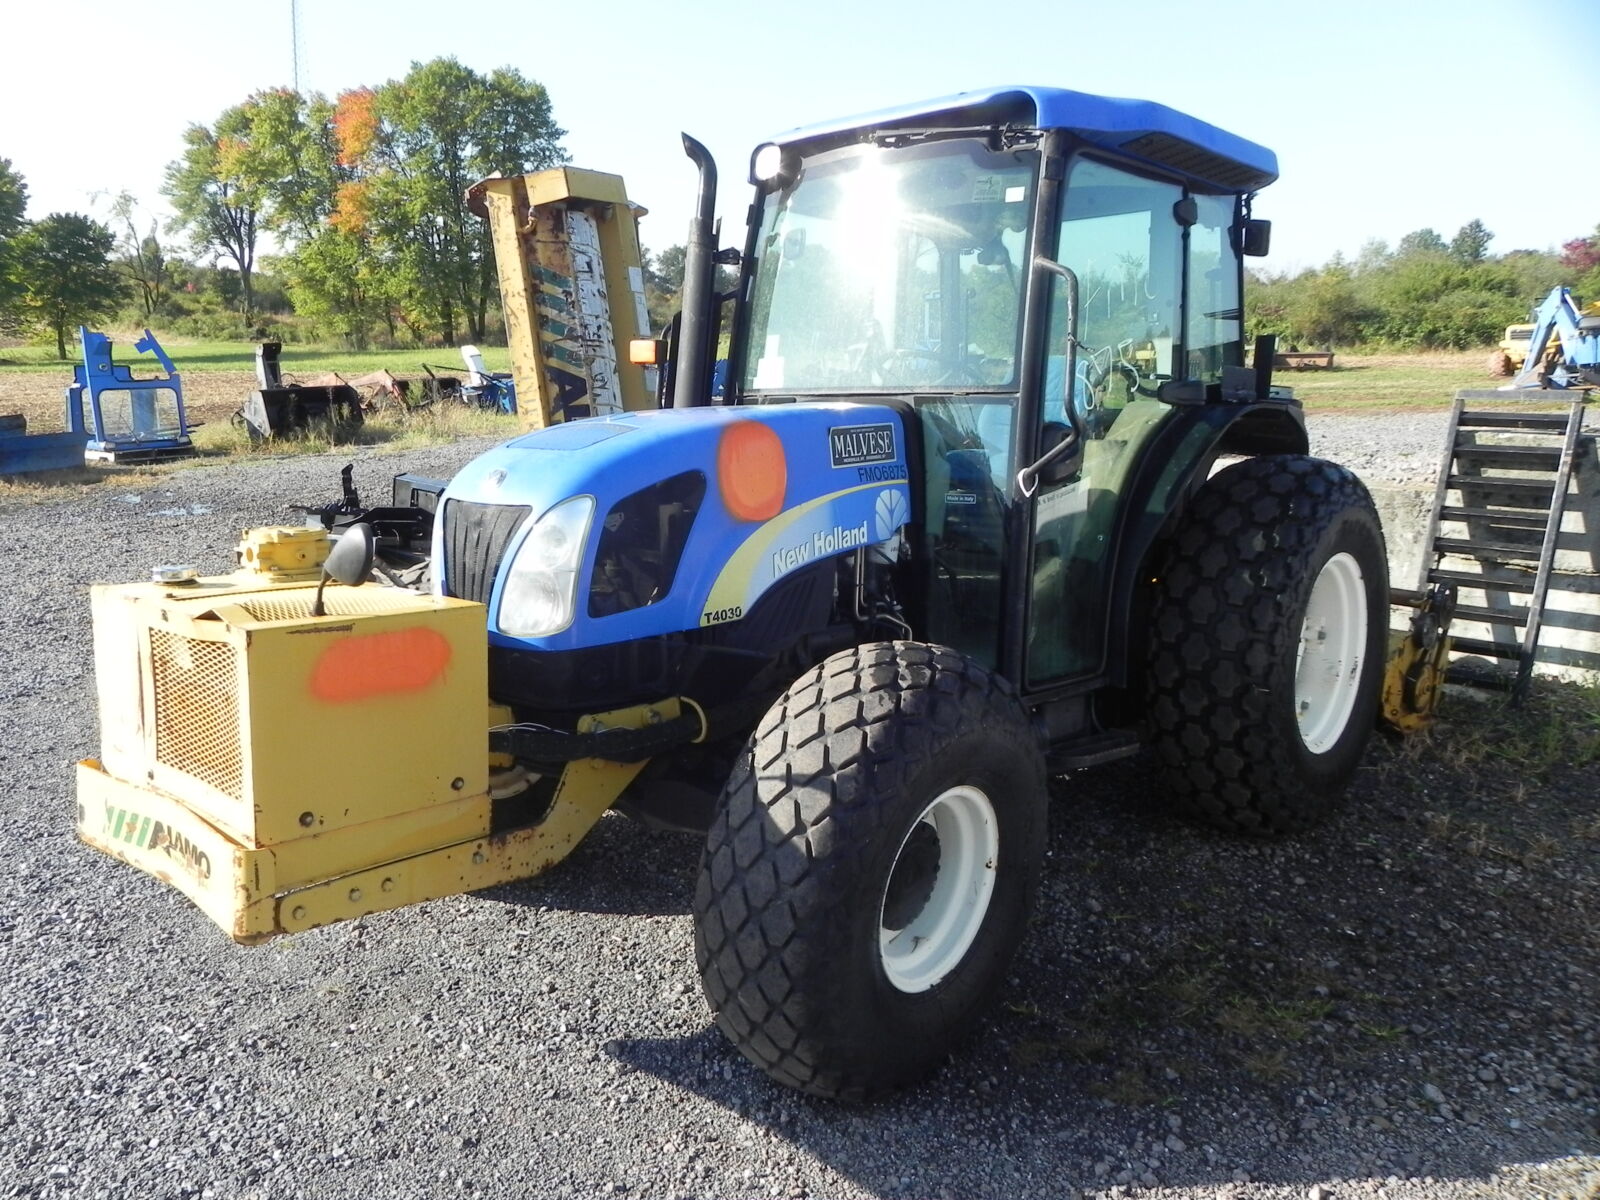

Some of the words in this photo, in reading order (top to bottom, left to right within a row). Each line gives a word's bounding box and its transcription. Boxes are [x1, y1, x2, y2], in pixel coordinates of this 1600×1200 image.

[834, 431, 892, 458] MALVESE
[772, 541, 810, 578] New
[813, 520, 868, 557] Holland
[704, 606, 742, 624] T4030
